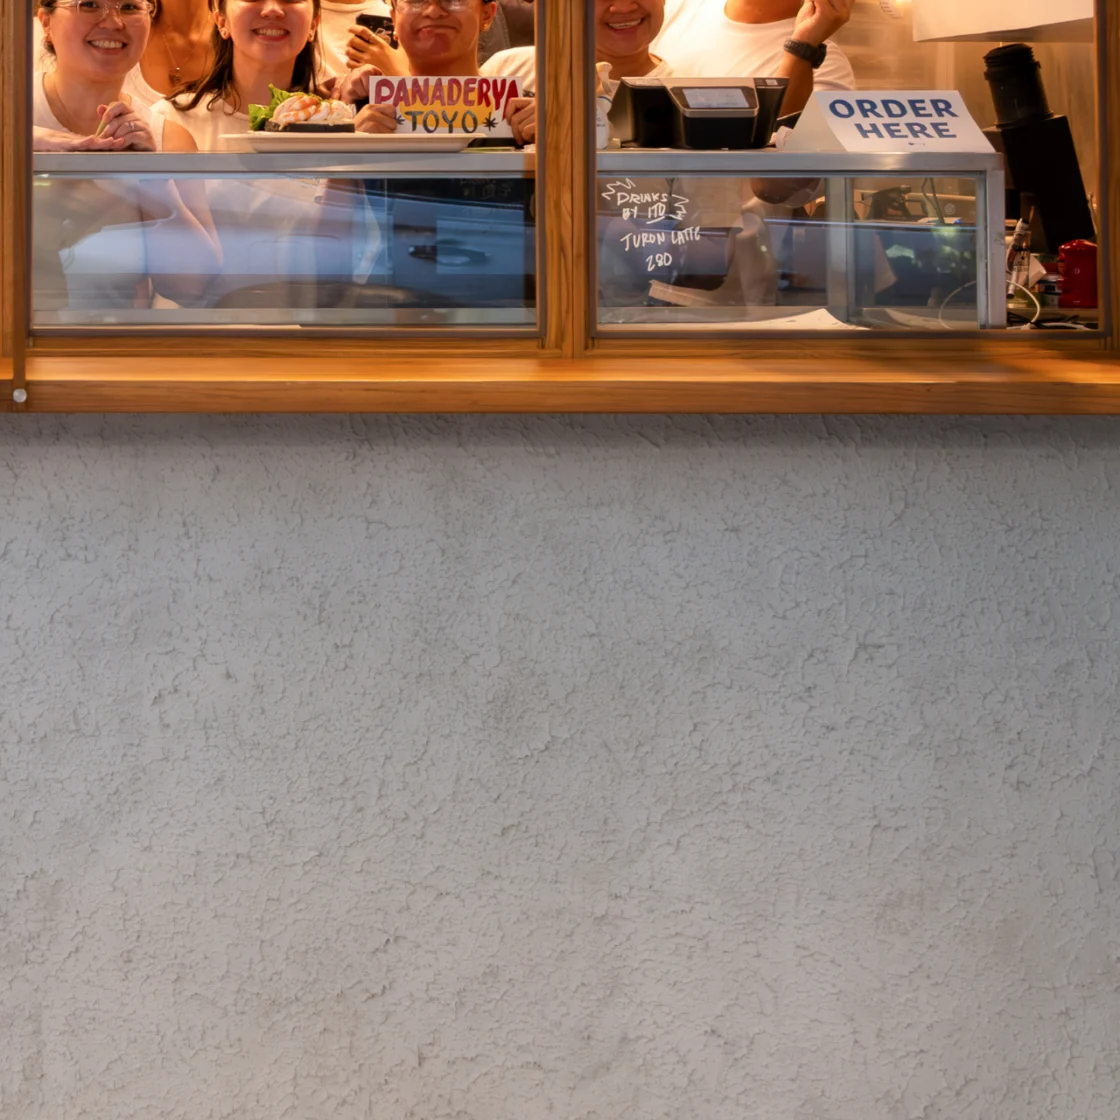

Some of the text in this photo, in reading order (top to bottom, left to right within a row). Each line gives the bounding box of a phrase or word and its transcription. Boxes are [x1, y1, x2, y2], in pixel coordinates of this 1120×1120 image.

[829, 99, 959, 119] ORDER
[405, 110, 478, 133] TOYO
[854, 122, 957, 139] HERE
[617, 192, 668, 206] DRINKS
[622, 202, 666, 220] BY ITO
[646, 252, 672, 272] 280
